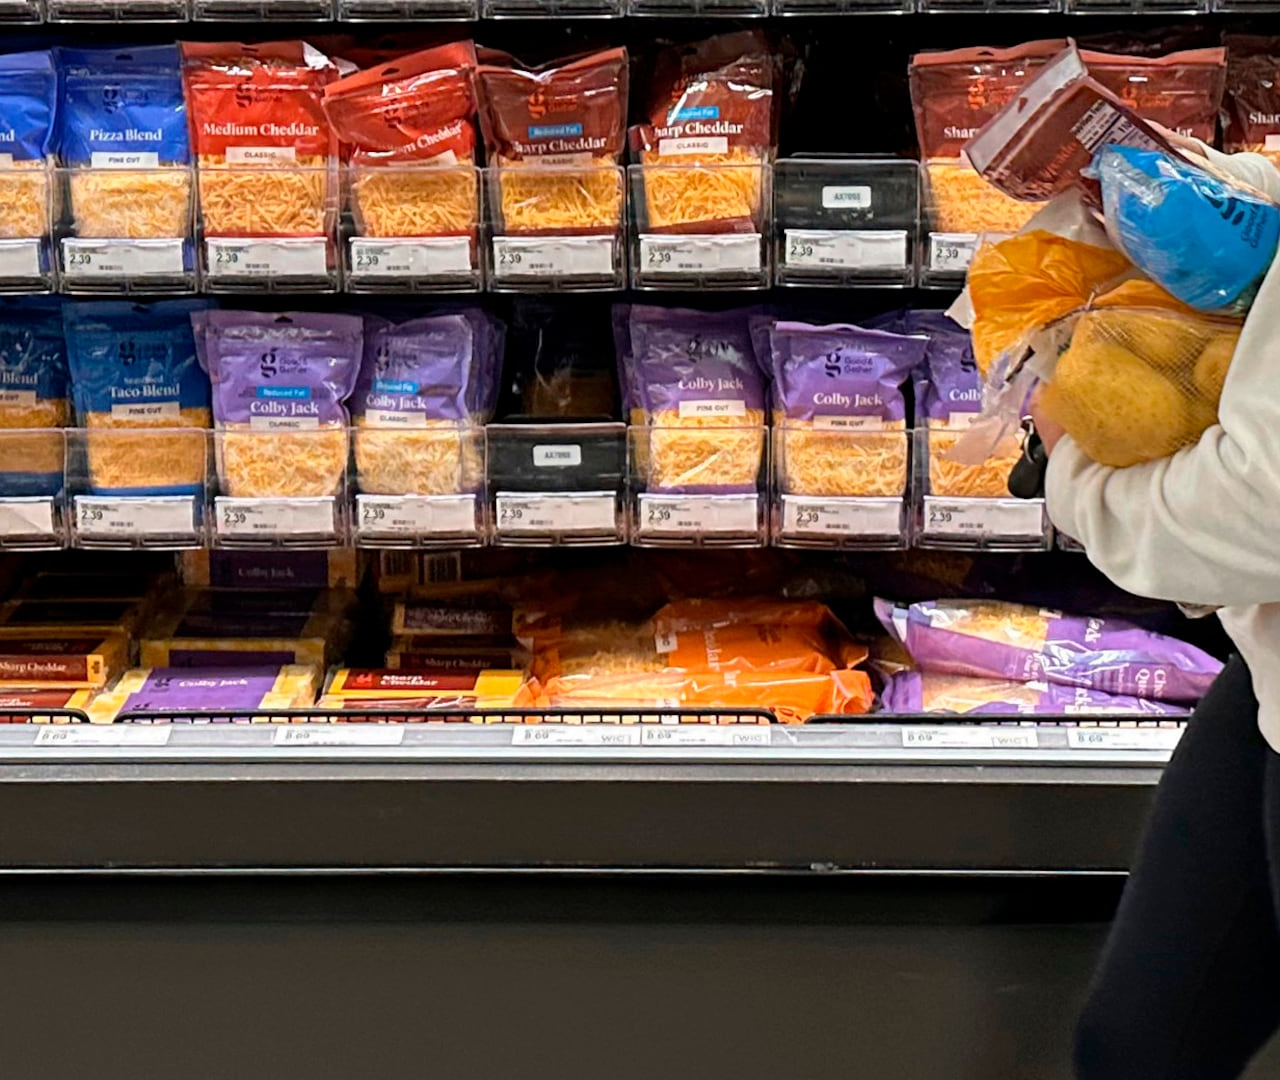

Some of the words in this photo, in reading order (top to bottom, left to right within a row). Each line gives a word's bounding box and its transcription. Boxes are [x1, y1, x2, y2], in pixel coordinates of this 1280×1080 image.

[90, 129, 121, 143] Pizza
[125, 128, 162, 141] Blend
[203, 122, 256, 136] Medium
[258, 122, 319, 137] Cheddar
[417, 121, 463, 150] Cheddar
[654, 124, 683, 139] harp
[685, 121, 744, 137] Cheddar
[356, 254, 379, 267] 2.39
[649, 252, 671, 264] 2.39
[678, 376, 716, 393] Colby
[718, 376, 744, 392] Jack
[366, 394, 397, 411] Colby
[400, 394, 426, 410] Jack
[814, 392, 851, 409] Colby
[854, 392, 884, 408] Jack
[250, 401, 287, 418] Colby
[290, 401, 319, 416] Jack
[501, 508, 523, 520] 2.39
[648, 511, 670, 522] 2.39
[0, 661, 25, 674] Sharp
[27, 661, 67, 674] Cheddar
[180, 676, 218, 689] Colby
[220, 677, 248, 689] Jack
[382, 675, 423, 686] Sharp
